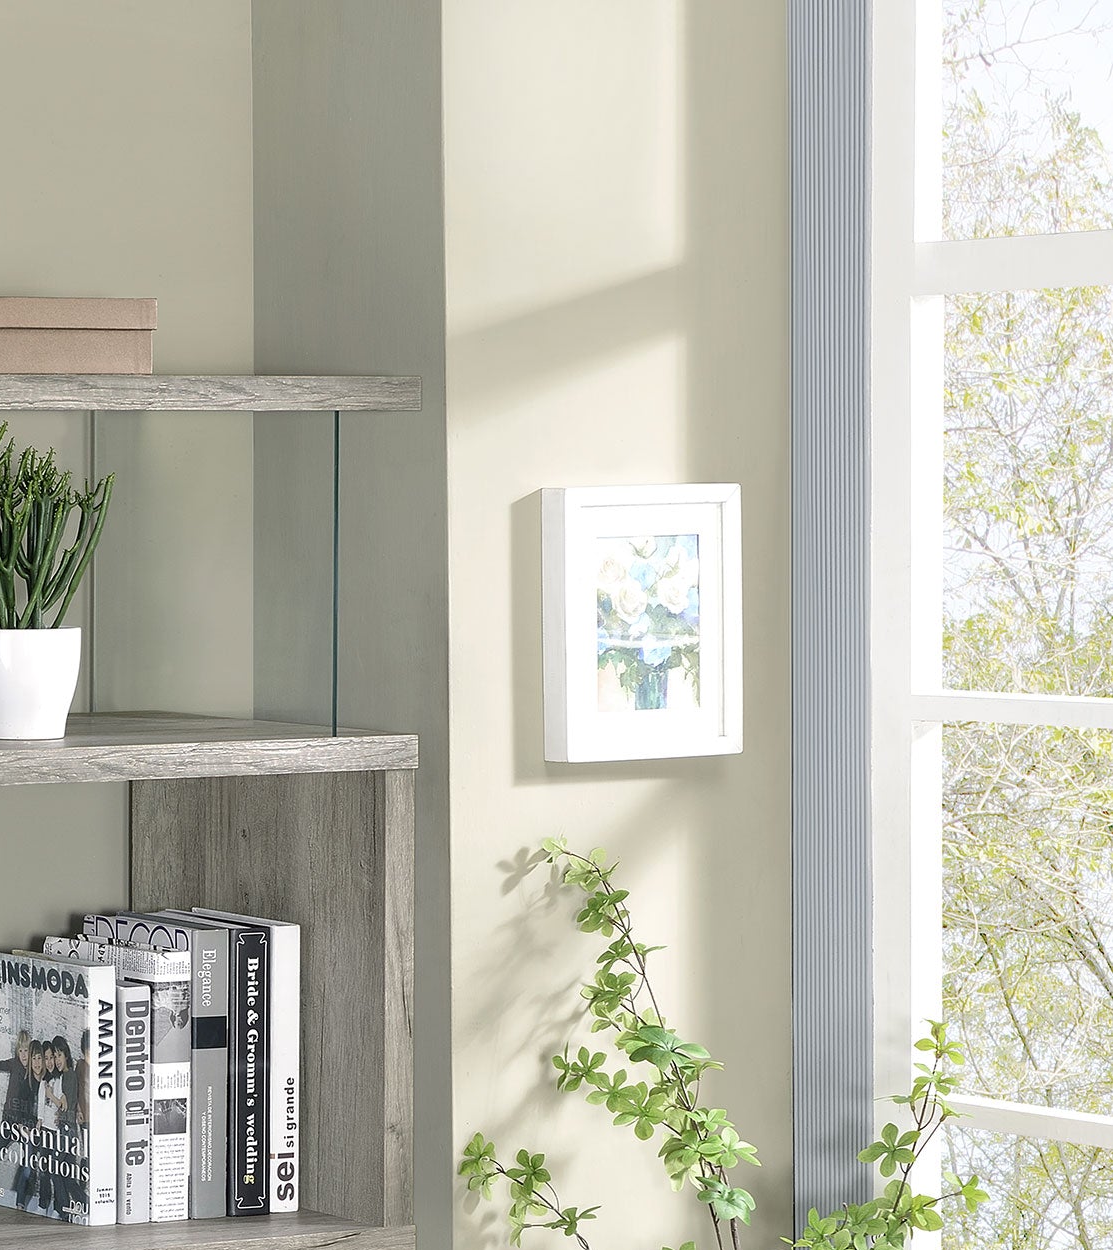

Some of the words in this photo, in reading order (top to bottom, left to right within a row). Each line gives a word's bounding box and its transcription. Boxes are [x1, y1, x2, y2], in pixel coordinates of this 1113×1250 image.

[197, 948, 217, 1007] Elegance
[247, 957, 260, 1007] Bride
[246, 1009, 260, 1027] &
[97, 998, 114, 1101] AMANG
[125, 1000, 150, 1092] Dentro
[246, 1028, 259, 1107] Gromm's
[125, 1100, 150, 1126] di
[284, 1077, 297, 1130] grande
[0, 1119, 89, 1159] essential
[0, 1142, 90, 1183] collections
[125, 1139, 149, 1167] te
[242, 1113, 258, 1185] wedding
[283, 1135, 295, 1148] si
[269, 1152, 295, 1201] sei
